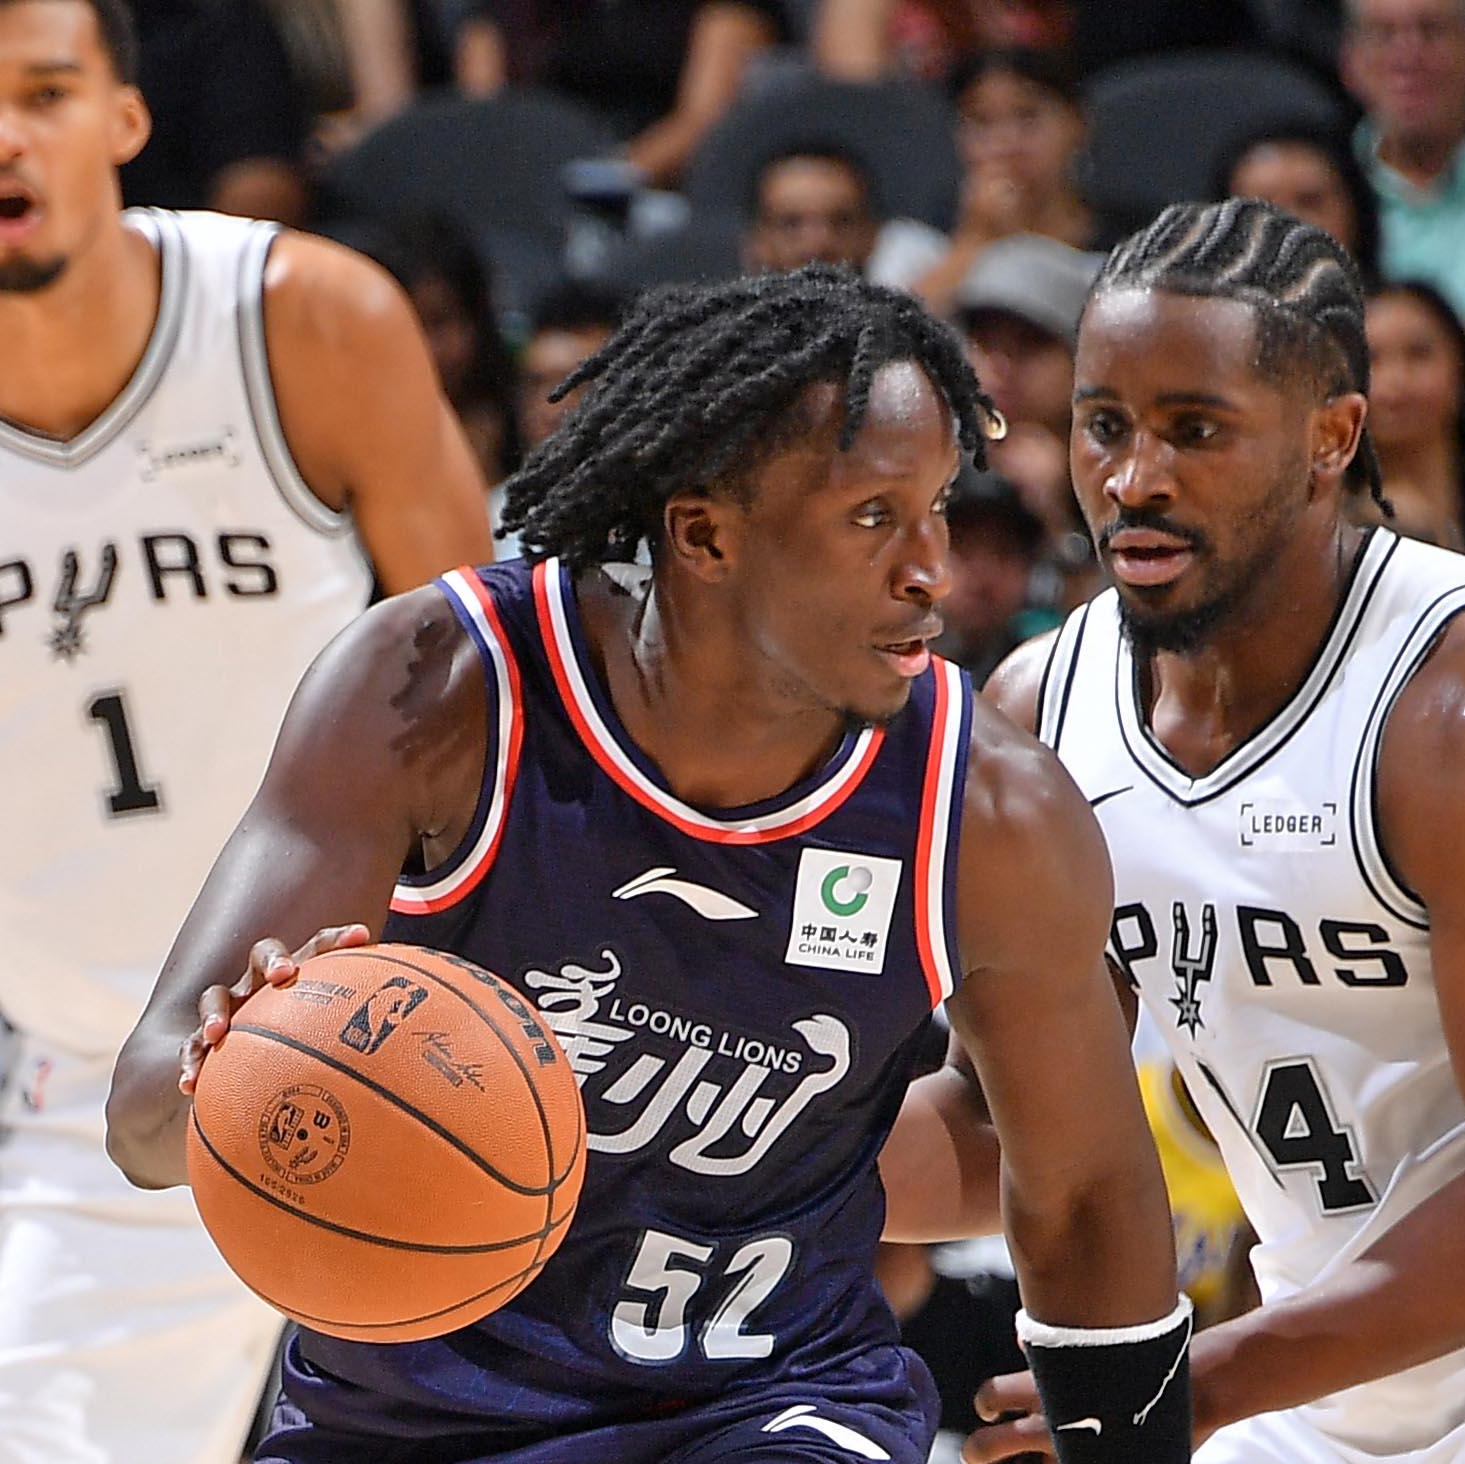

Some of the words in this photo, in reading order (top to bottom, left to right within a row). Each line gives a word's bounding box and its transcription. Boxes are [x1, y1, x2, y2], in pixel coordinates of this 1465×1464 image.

[87, 691, 163, 816] 1
[1252, 814, 1322, 833] LEDGER
[798, 943, 841, 957] CHINA
[845, 949, 875, 961] LIFE
[801, 923, 878, 948] 中国人寿
[1110, 901, 1408, 1040] PURS
[608, 998, 713, 1048] LOONG
[716, 1031, 803, 1074] LIONS
[610, 1229, 792, 1362] 52
